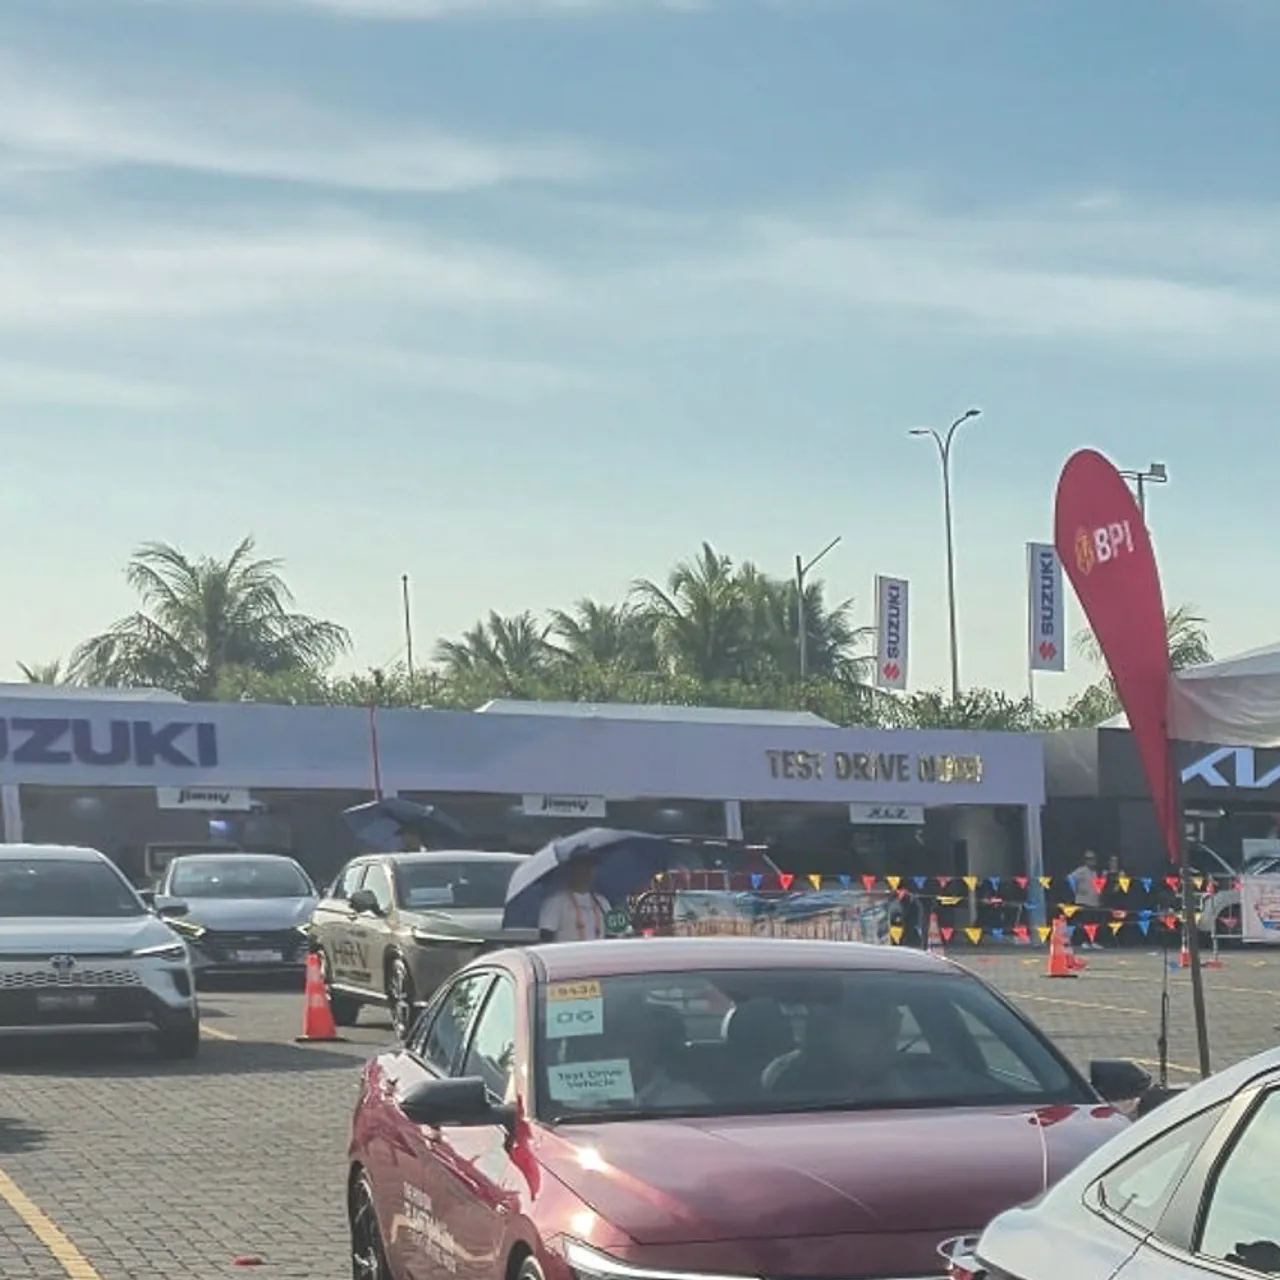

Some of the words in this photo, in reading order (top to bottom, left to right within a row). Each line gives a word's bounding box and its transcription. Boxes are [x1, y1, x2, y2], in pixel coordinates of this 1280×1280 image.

[1092, 520, 1134, 562] BPI
[1040, 552, 1054, 636] SUZUKI
[888, 585, 900, 659] SUZUKI
[0, 717, 218, 767] ZUKI
[835, 752, 911, 782] DRIVE
